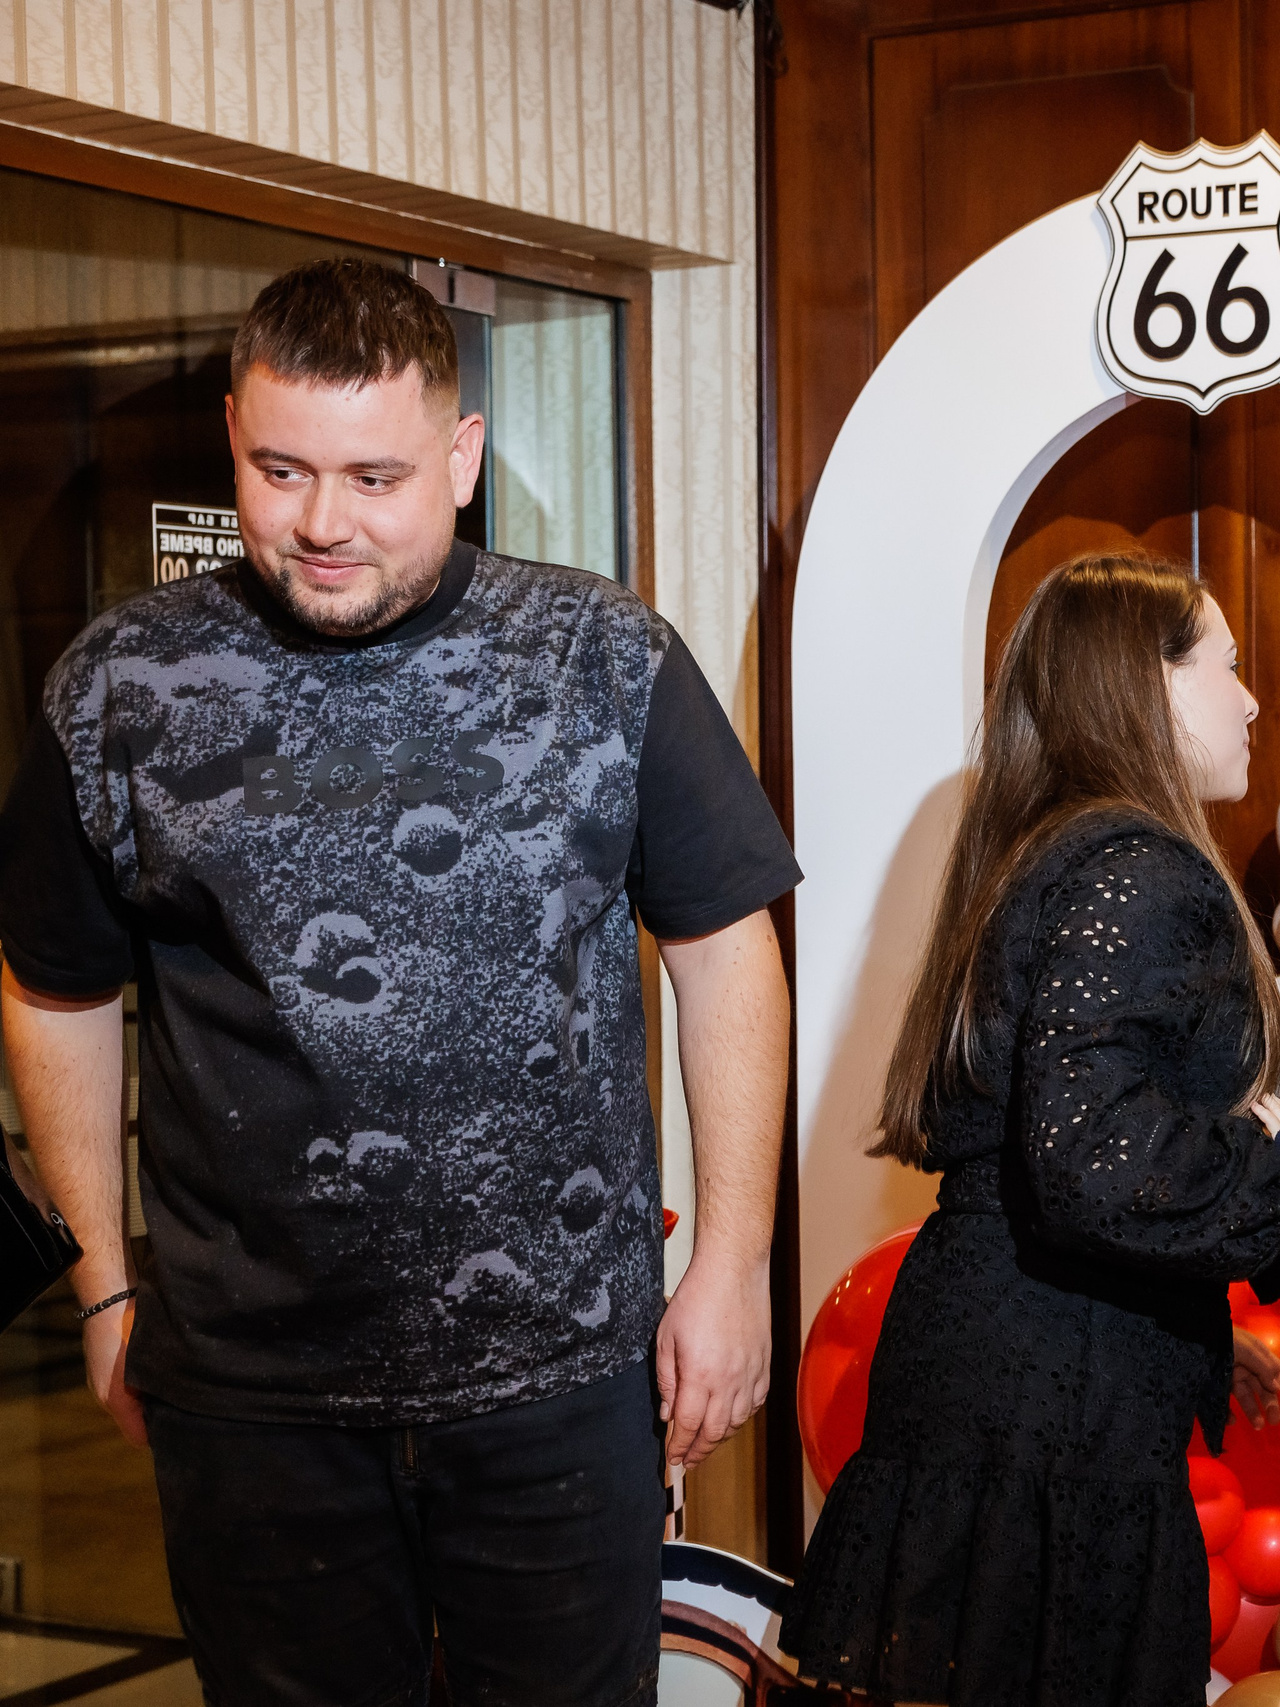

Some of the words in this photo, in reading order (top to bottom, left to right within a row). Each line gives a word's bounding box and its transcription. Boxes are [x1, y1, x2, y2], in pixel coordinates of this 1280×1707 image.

[1137, 181, 1259, 225] ROUTE
[1133, 242, 1271, 363] 66
[242, 728, 506, 816] BOSS
